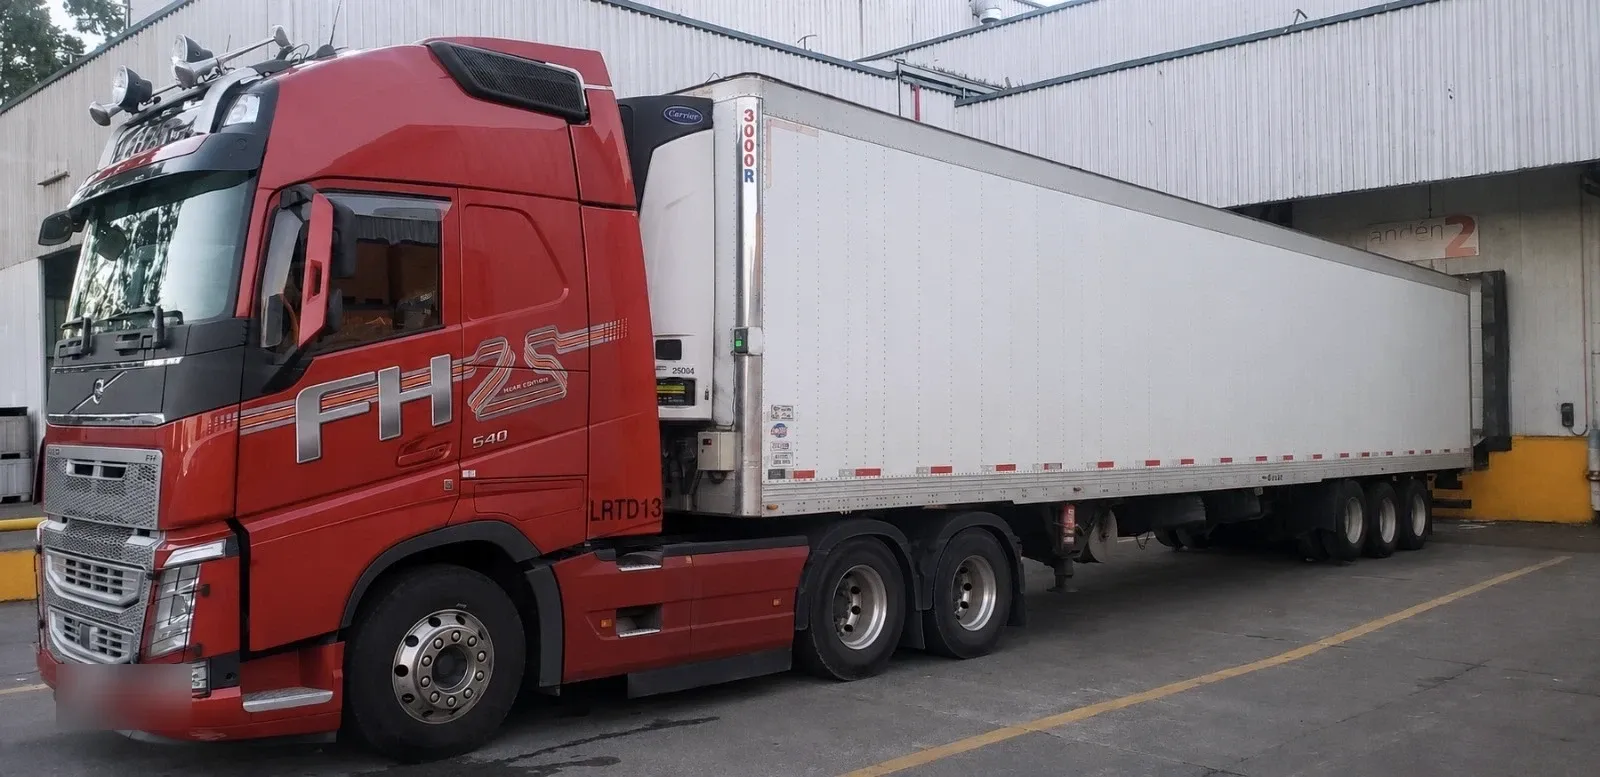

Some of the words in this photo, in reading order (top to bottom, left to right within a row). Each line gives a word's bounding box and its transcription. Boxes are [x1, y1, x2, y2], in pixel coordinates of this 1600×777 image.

[668, 109, 699, 120] Carrier
[743, 108, 755, 184] 3000R
[1369, 221, 1444, 243] andén
[1444, 214, 1476, 258] 2
[672, 367, 695, 375] 25004
[296, 354, 452, 463] FH
[472, 430, 508, 449] 540
[590, 498, 662, 522] LRTD13
